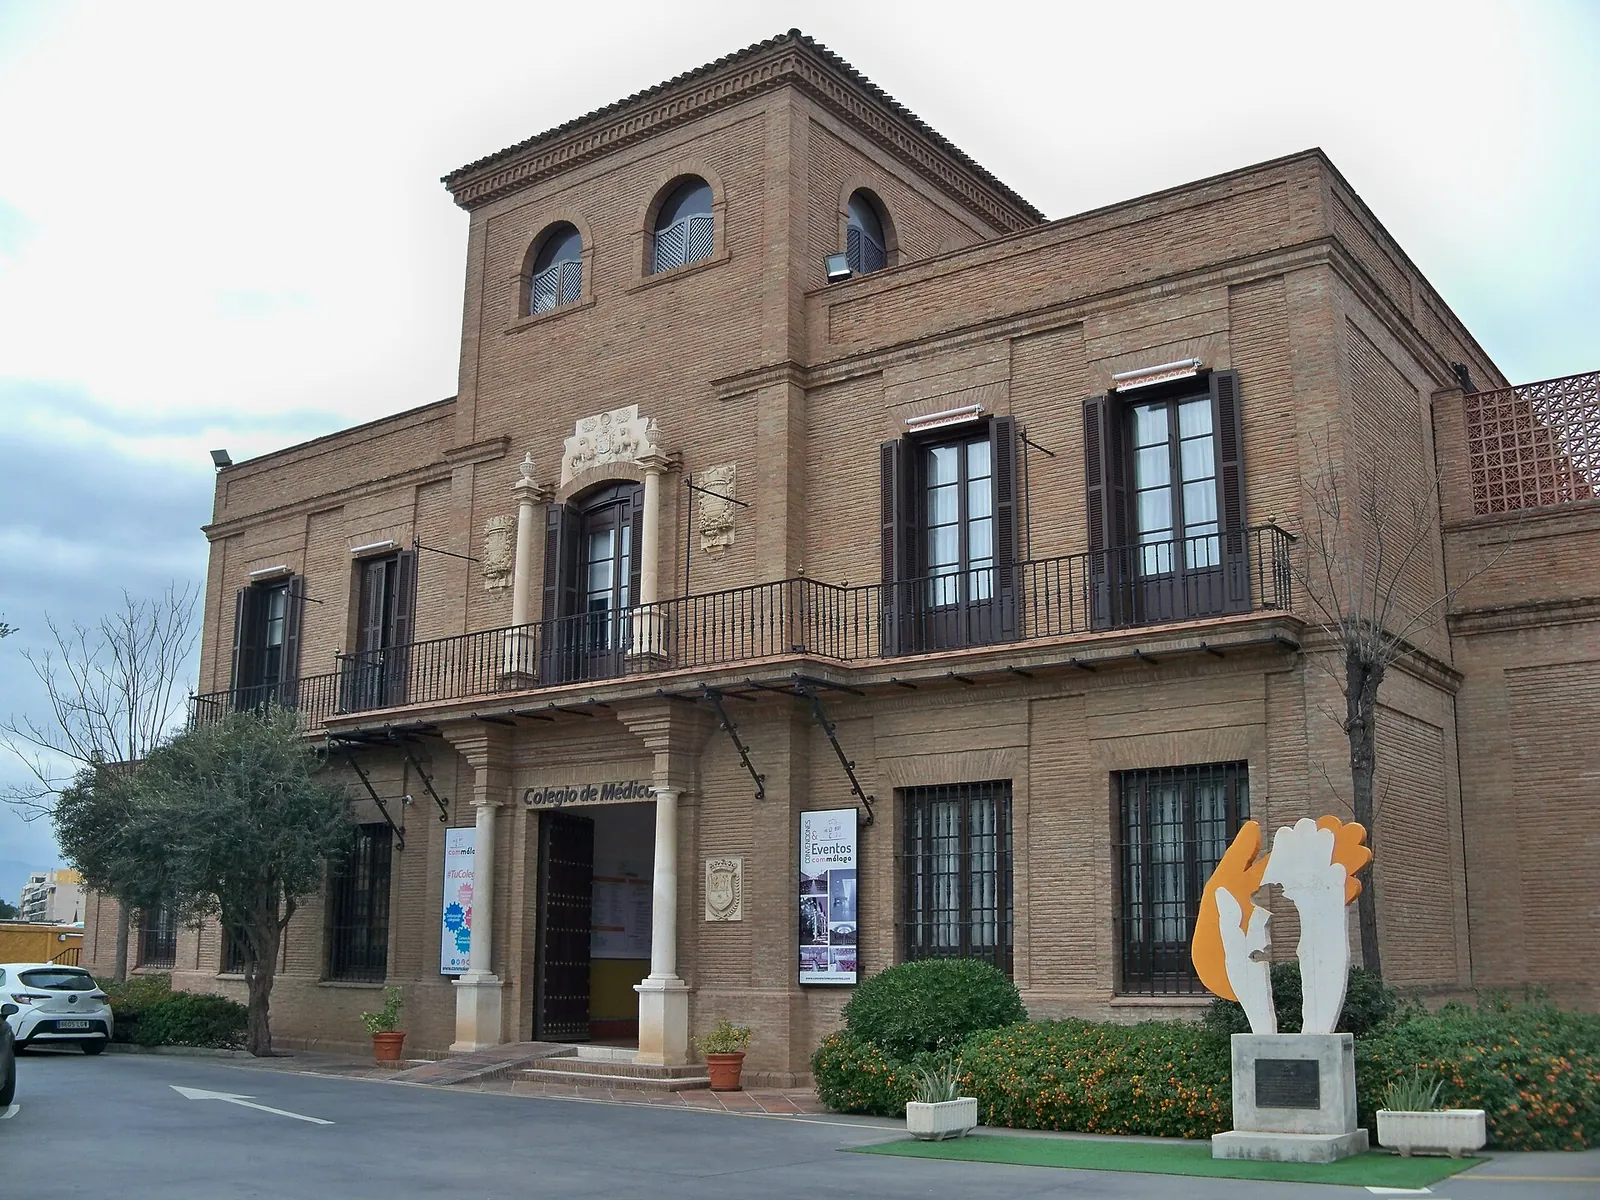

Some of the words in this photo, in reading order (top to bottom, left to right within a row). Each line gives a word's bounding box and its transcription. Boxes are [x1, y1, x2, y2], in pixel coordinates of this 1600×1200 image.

[523, 785, 578, 807] Colegio
[580, 784, 598, 801] de
[600, 780, 658, 801] Médico
[811, 830, 818, 841] &
[811, 843, 852, 855] Eventos
[447, 869, 475, 881] #TuColeg
